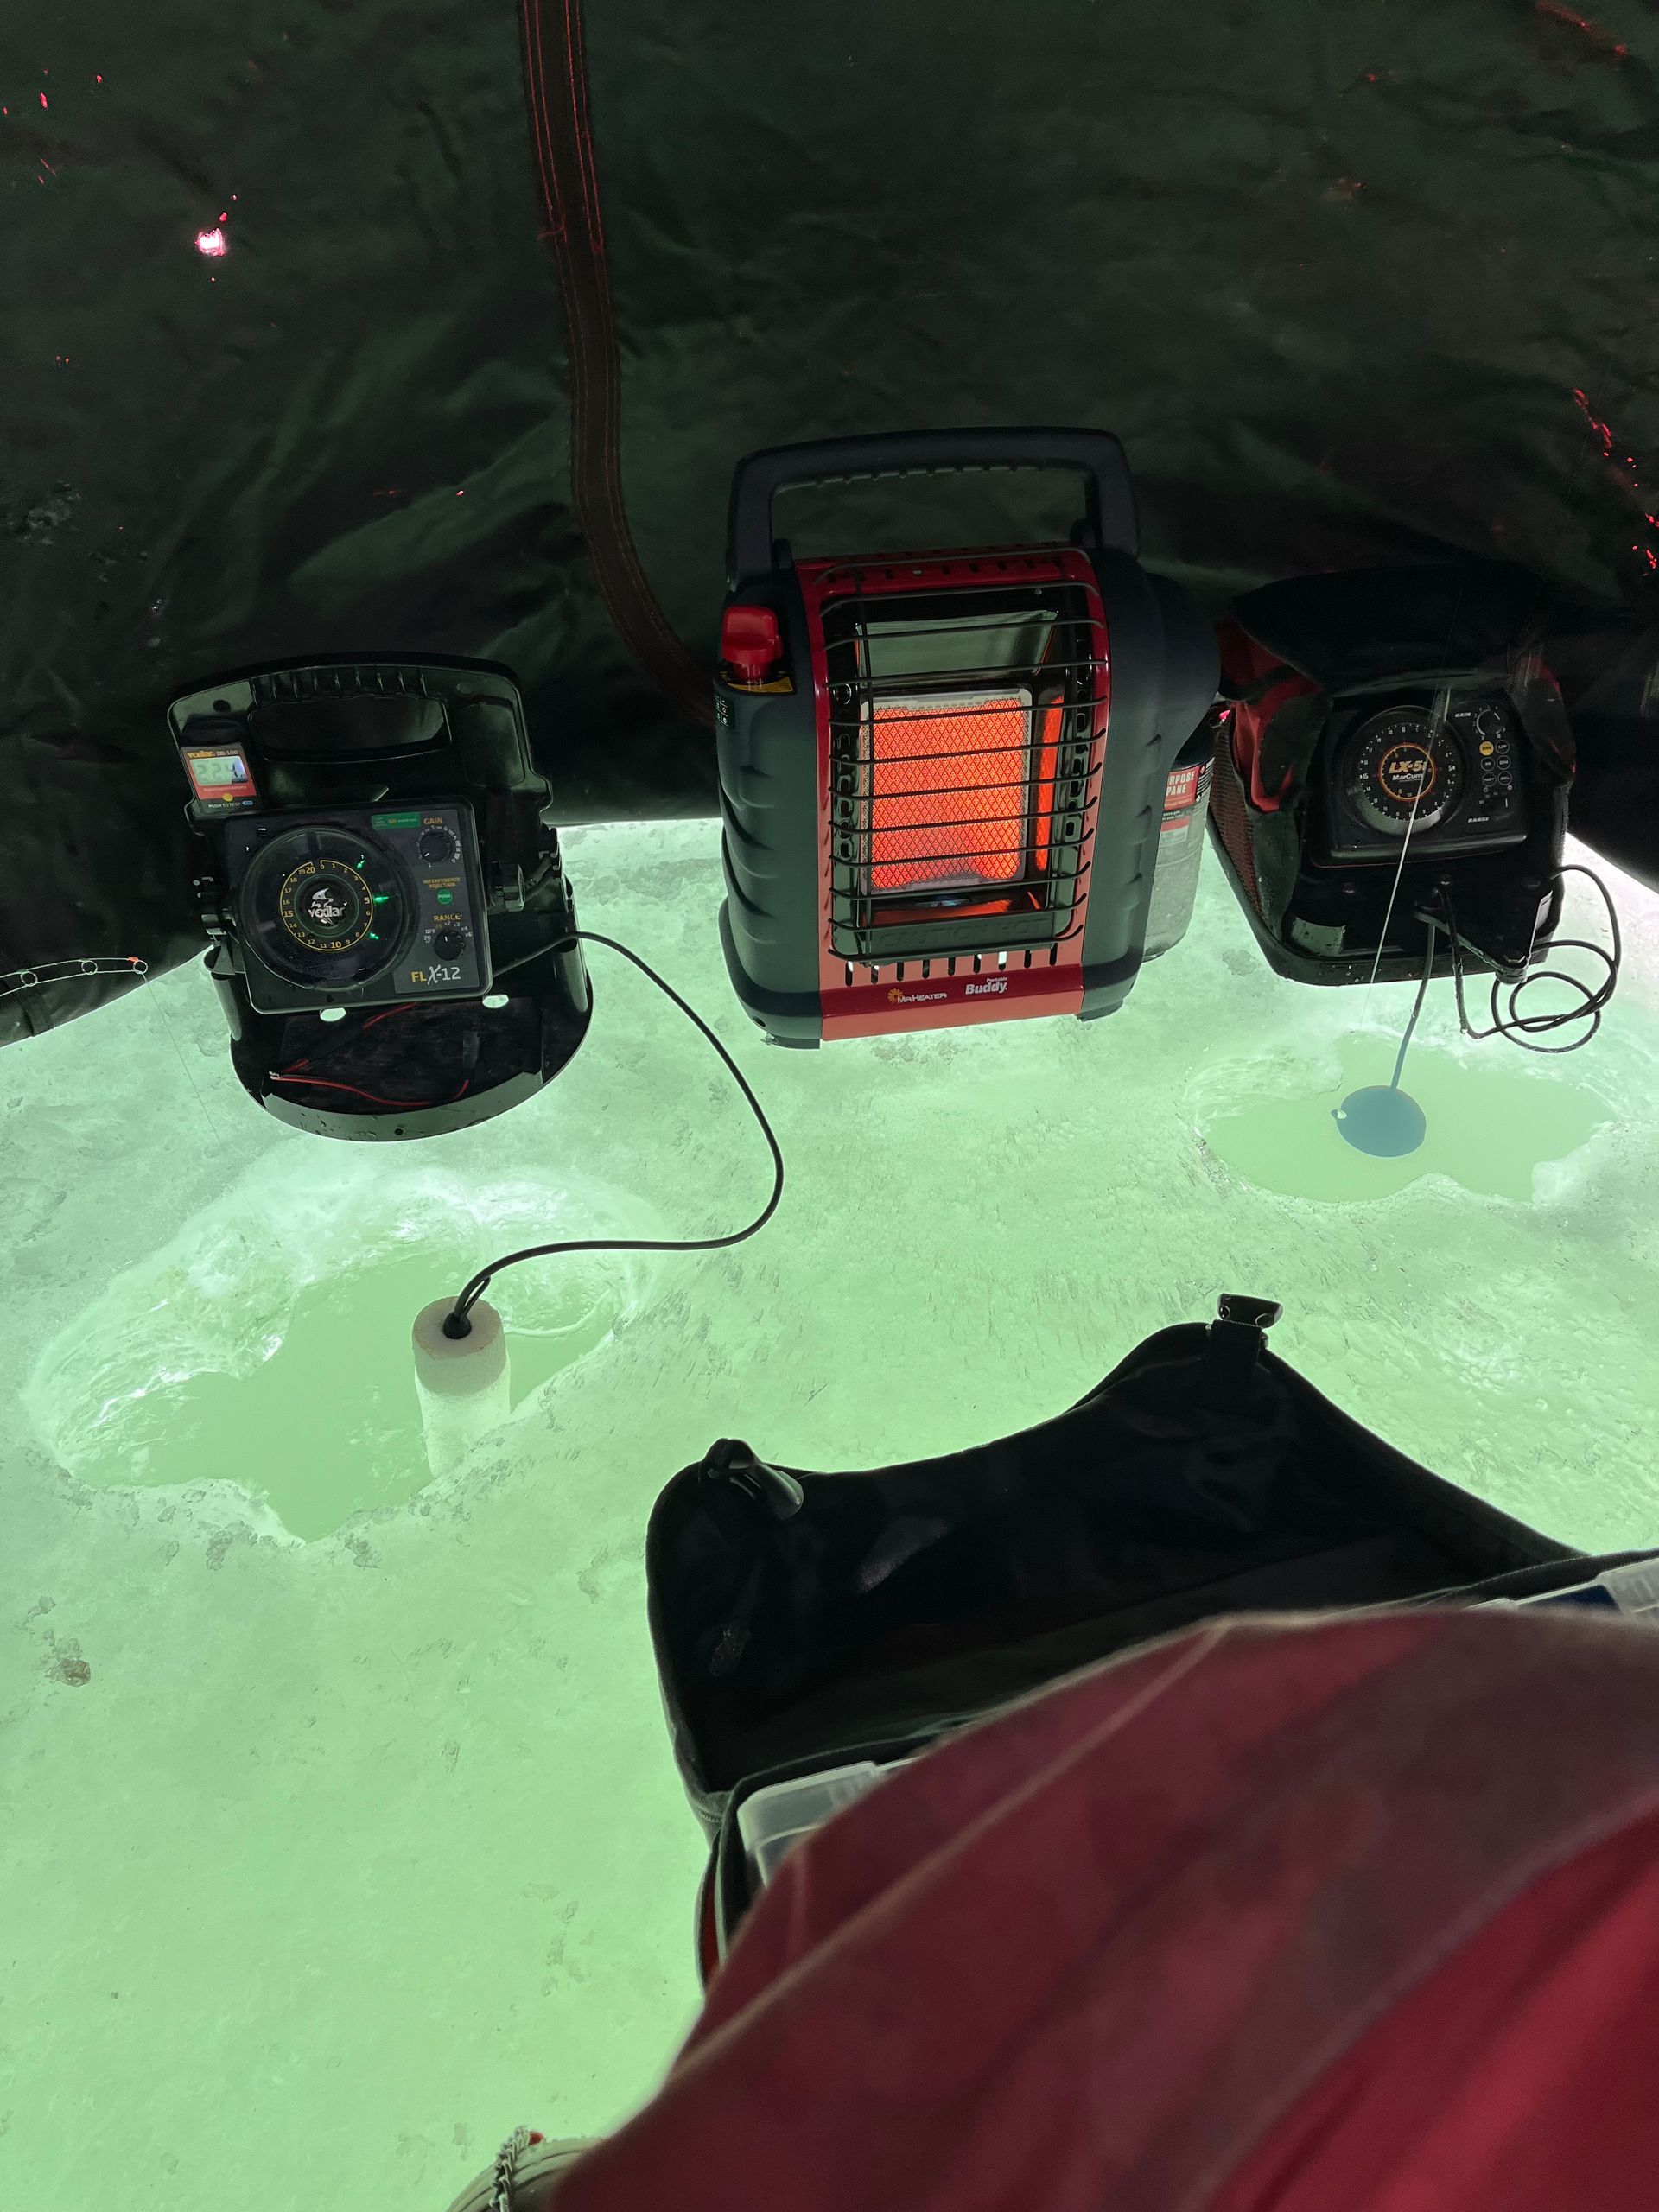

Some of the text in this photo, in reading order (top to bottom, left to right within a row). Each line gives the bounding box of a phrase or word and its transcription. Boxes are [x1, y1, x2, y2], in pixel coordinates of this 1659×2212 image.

[1167, 771, 1196, 785] RPOSE
[1166, 784, 1187, 797] PANE
[965, 982, 1007, 995] Buddy
[912, 992, 947, 1002] HEATER
